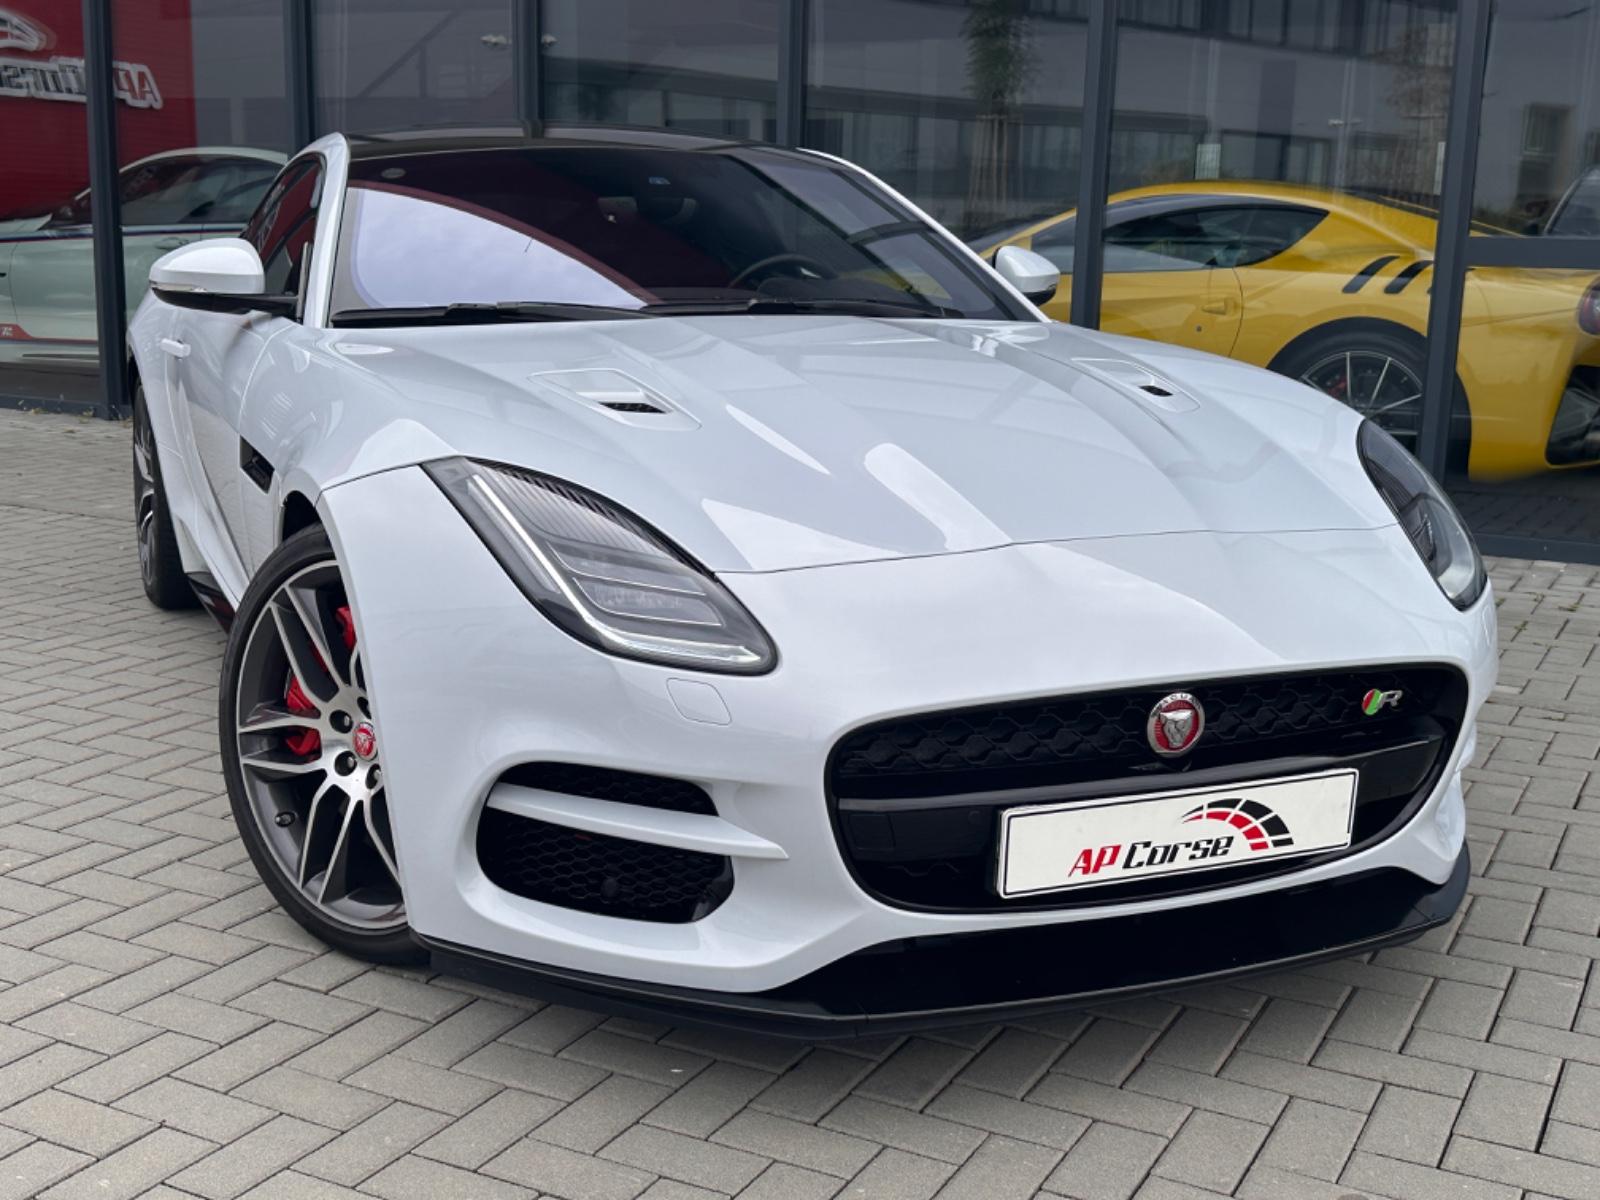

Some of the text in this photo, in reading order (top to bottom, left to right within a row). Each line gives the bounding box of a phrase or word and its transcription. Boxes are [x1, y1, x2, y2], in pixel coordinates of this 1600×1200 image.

[1379, 690, 1403, 708] R
[1068, 835, 1234, 878] AP Corse
